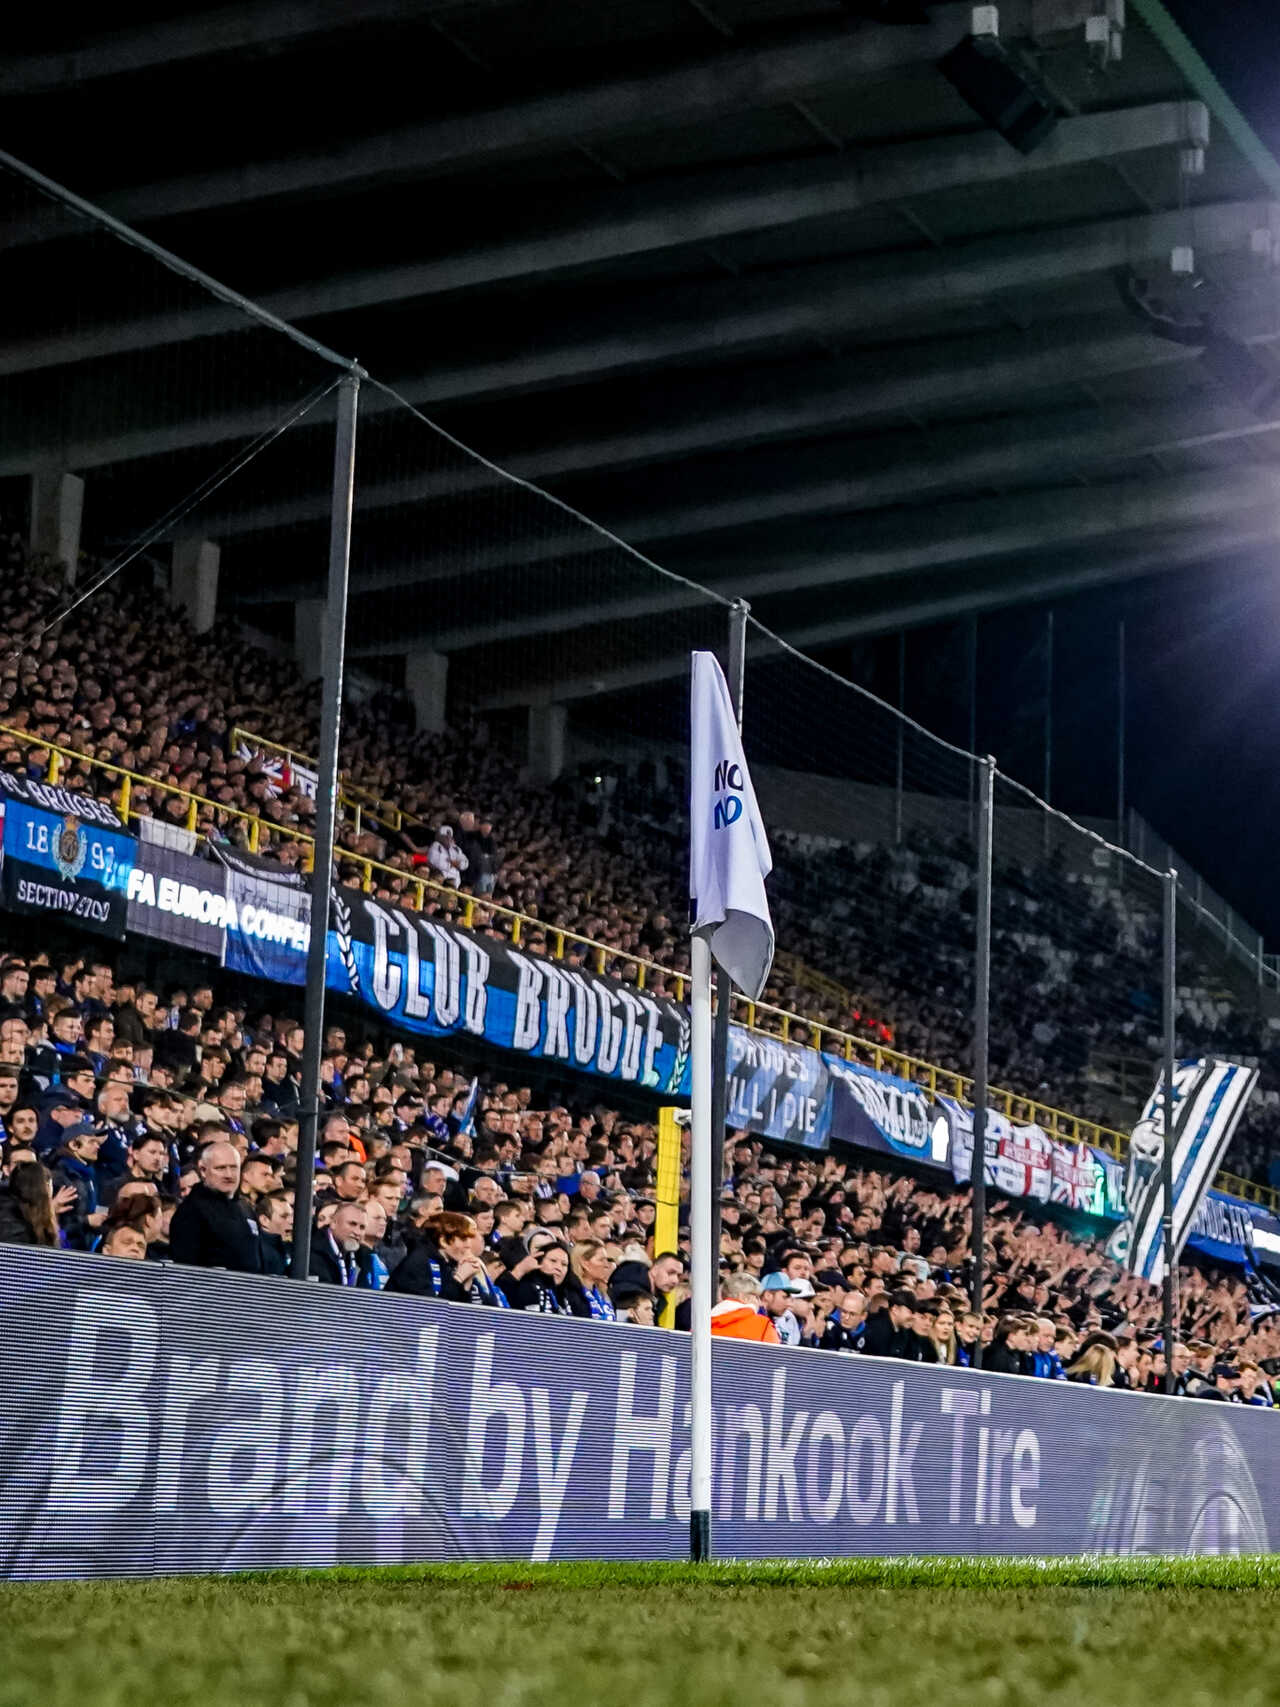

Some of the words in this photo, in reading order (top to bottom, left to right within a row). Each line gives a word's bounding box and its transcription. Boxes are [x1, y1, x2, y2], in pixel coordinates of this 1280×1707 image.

[714, 760, 744, 791] NO
[26, 821, 49, 853] 18
[17, 879, 79, 912] SECTION
[158, 877, 239, 930] EUROPA
[241, 904, 311, 953] CONFE
[363, 900, 491, 1036] CLUB
[506, 949, 664, 1088] BRUGGE
[726, 1073, 764, 1121] ILL
[782, 1091, 818, 1134] DIE
[45, 1289, 440, 1518] Brand
[460, 1332, 589, 1563] by
[607, 1350, 927, 1527] Hankook
[940, 1388, 1041, 1529] Tire
